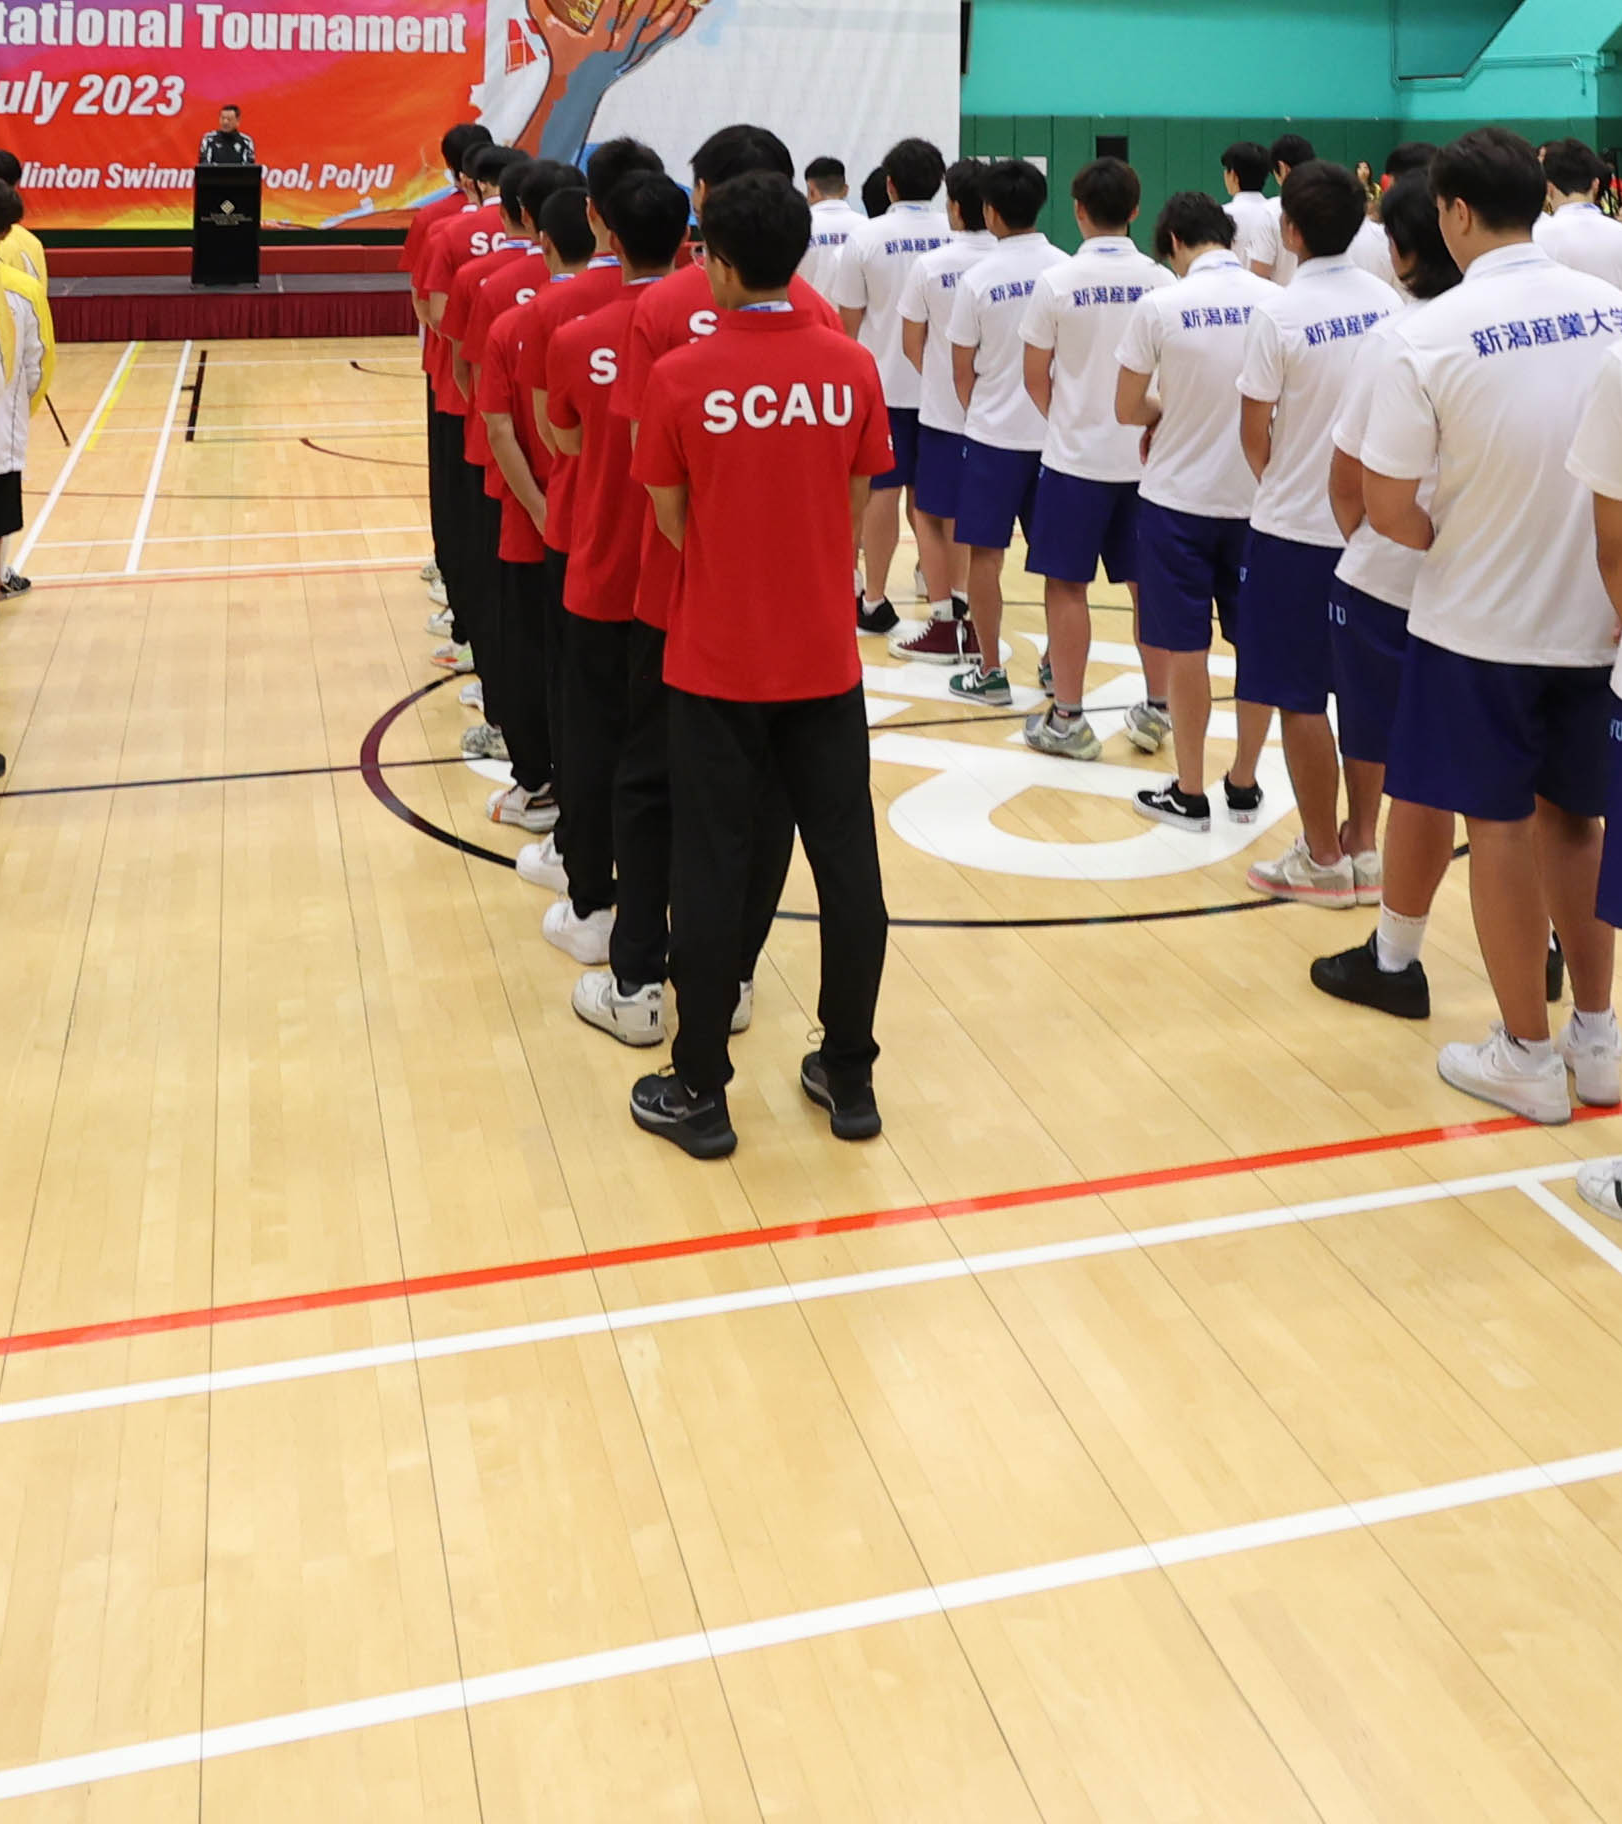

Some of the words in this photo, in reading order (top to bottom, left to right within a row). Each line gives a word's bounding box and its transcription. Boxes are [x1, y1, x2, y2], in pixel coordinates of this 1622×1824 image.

[196, 3, 467, 54] Tournament
[71, 74, 185, 117] 2023
[19, 161, 101, 189] linton
[318, 163, 396, 194] PolyU
[702, 382, 854, 435] SCAU
